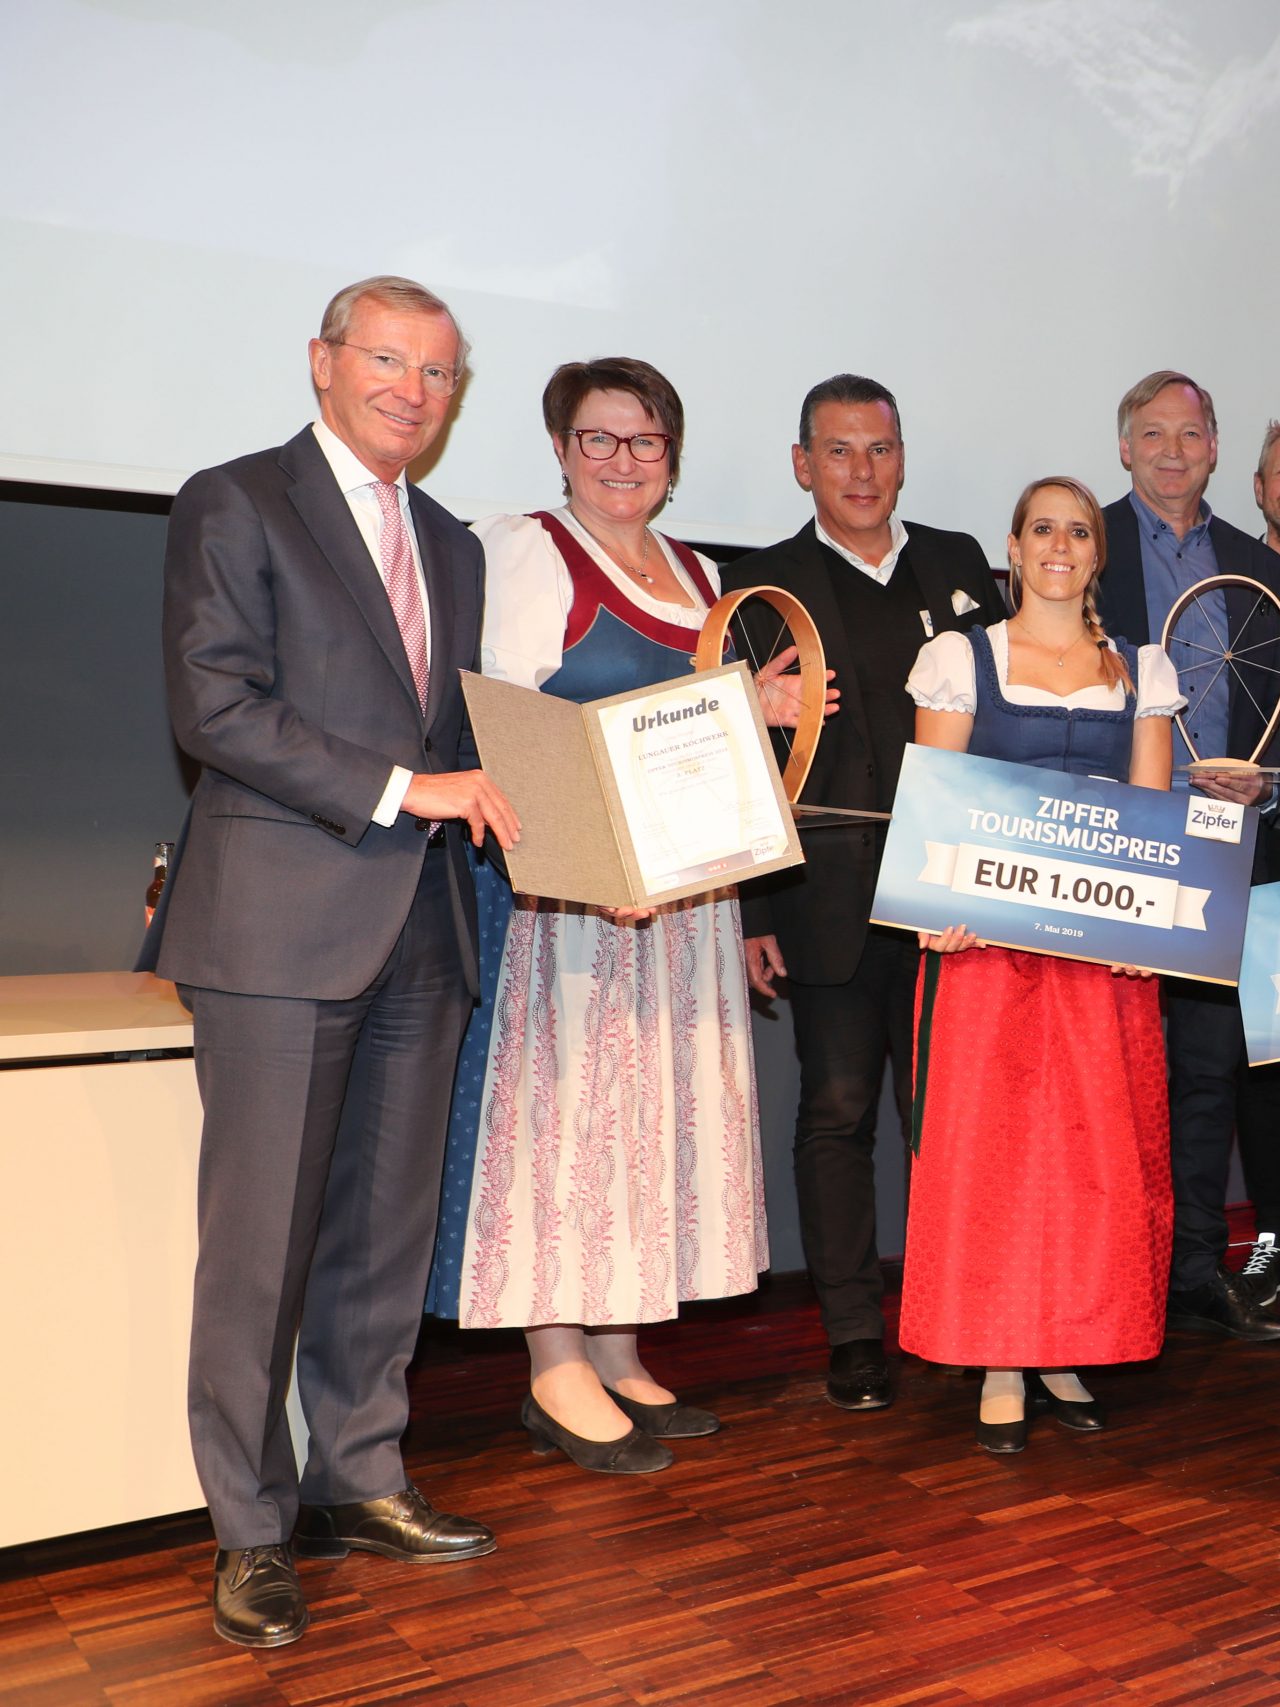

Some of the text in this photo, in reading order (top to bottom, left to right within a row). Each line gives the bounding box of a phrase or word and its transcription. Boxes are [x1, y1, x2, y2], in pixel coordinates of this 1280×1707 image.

[632, 697, 720, 733] Urkunde
[1035, 795, 1120, 831] ZIPFER
[1191, 809, 1238, 830] Zipfer
[967, 807, 1181, 866] TOURISMUSPREIS
[974, 858, 1156, 918] EUR 1.000,-
[1034, 922, 1084, 938] 7. Mai 2019
